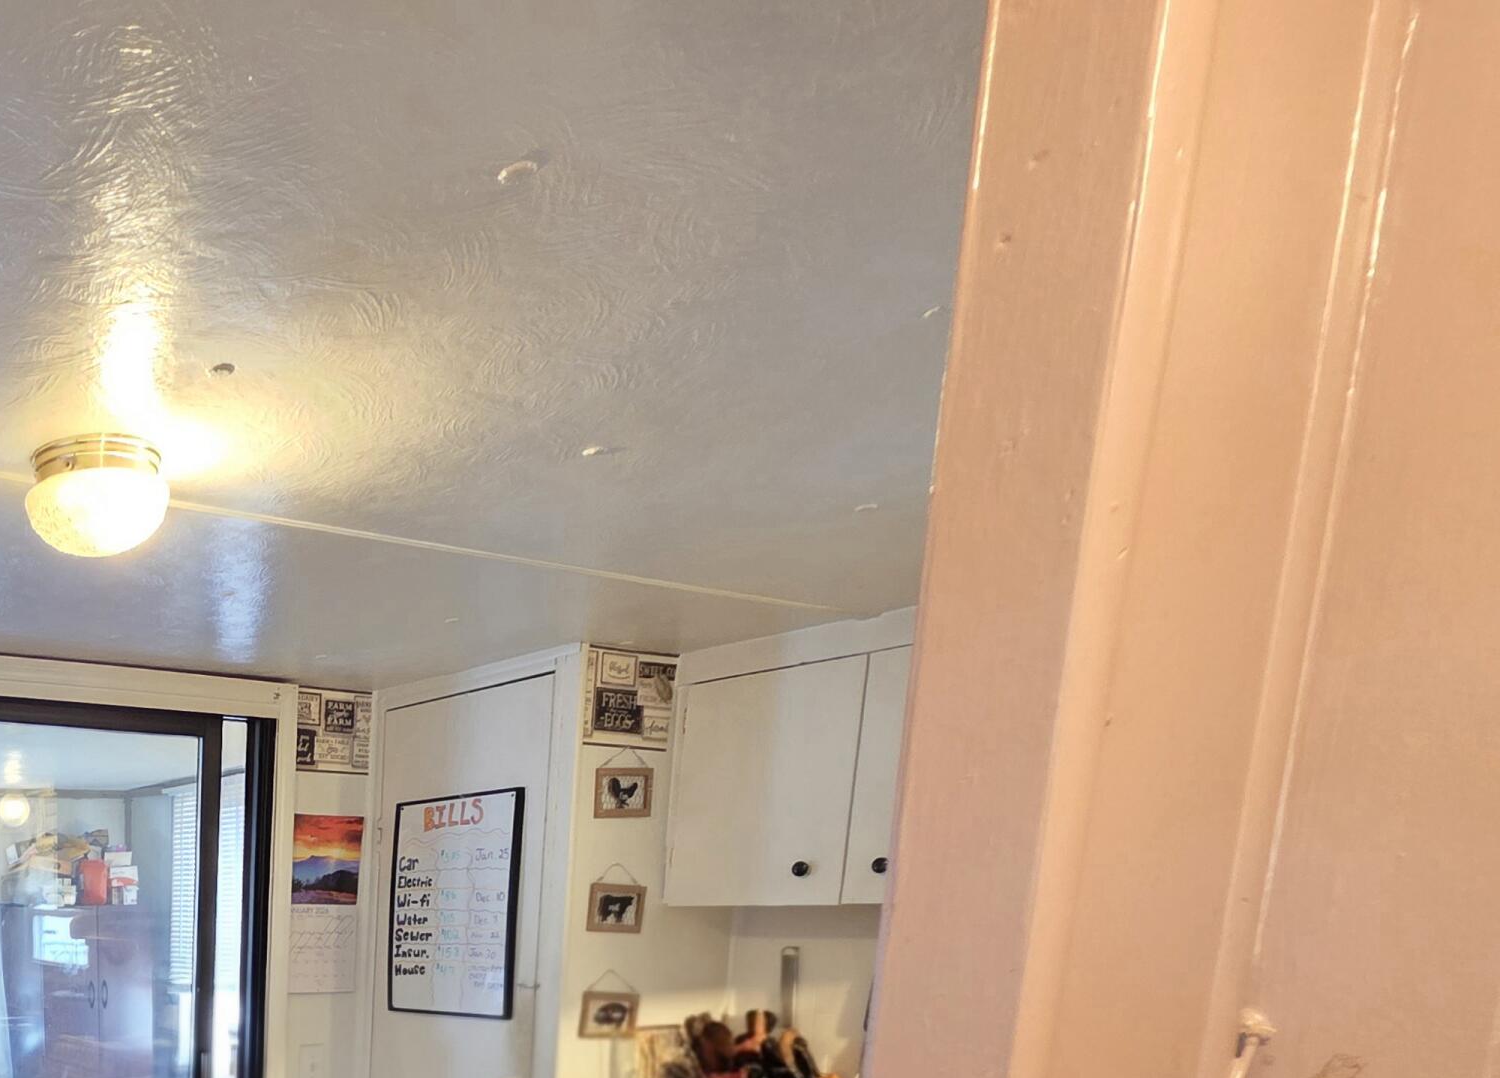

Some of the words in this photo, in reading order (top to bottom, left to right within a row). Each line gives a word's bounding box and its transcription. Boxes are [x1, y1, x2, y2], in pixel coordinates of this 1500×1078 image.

[602, 692, 637, 710] FRESH
[423, 799, 484, 832] BILLS
[398, 856, 420, 872] Car
[397, 876, 433, 889] Electric
[396, 893, 431, 908] Wi-fi
[395, 914, 429, 926] Water
[394, 929, 433, 942] Sewer
[394, 964, 426, 976] House
